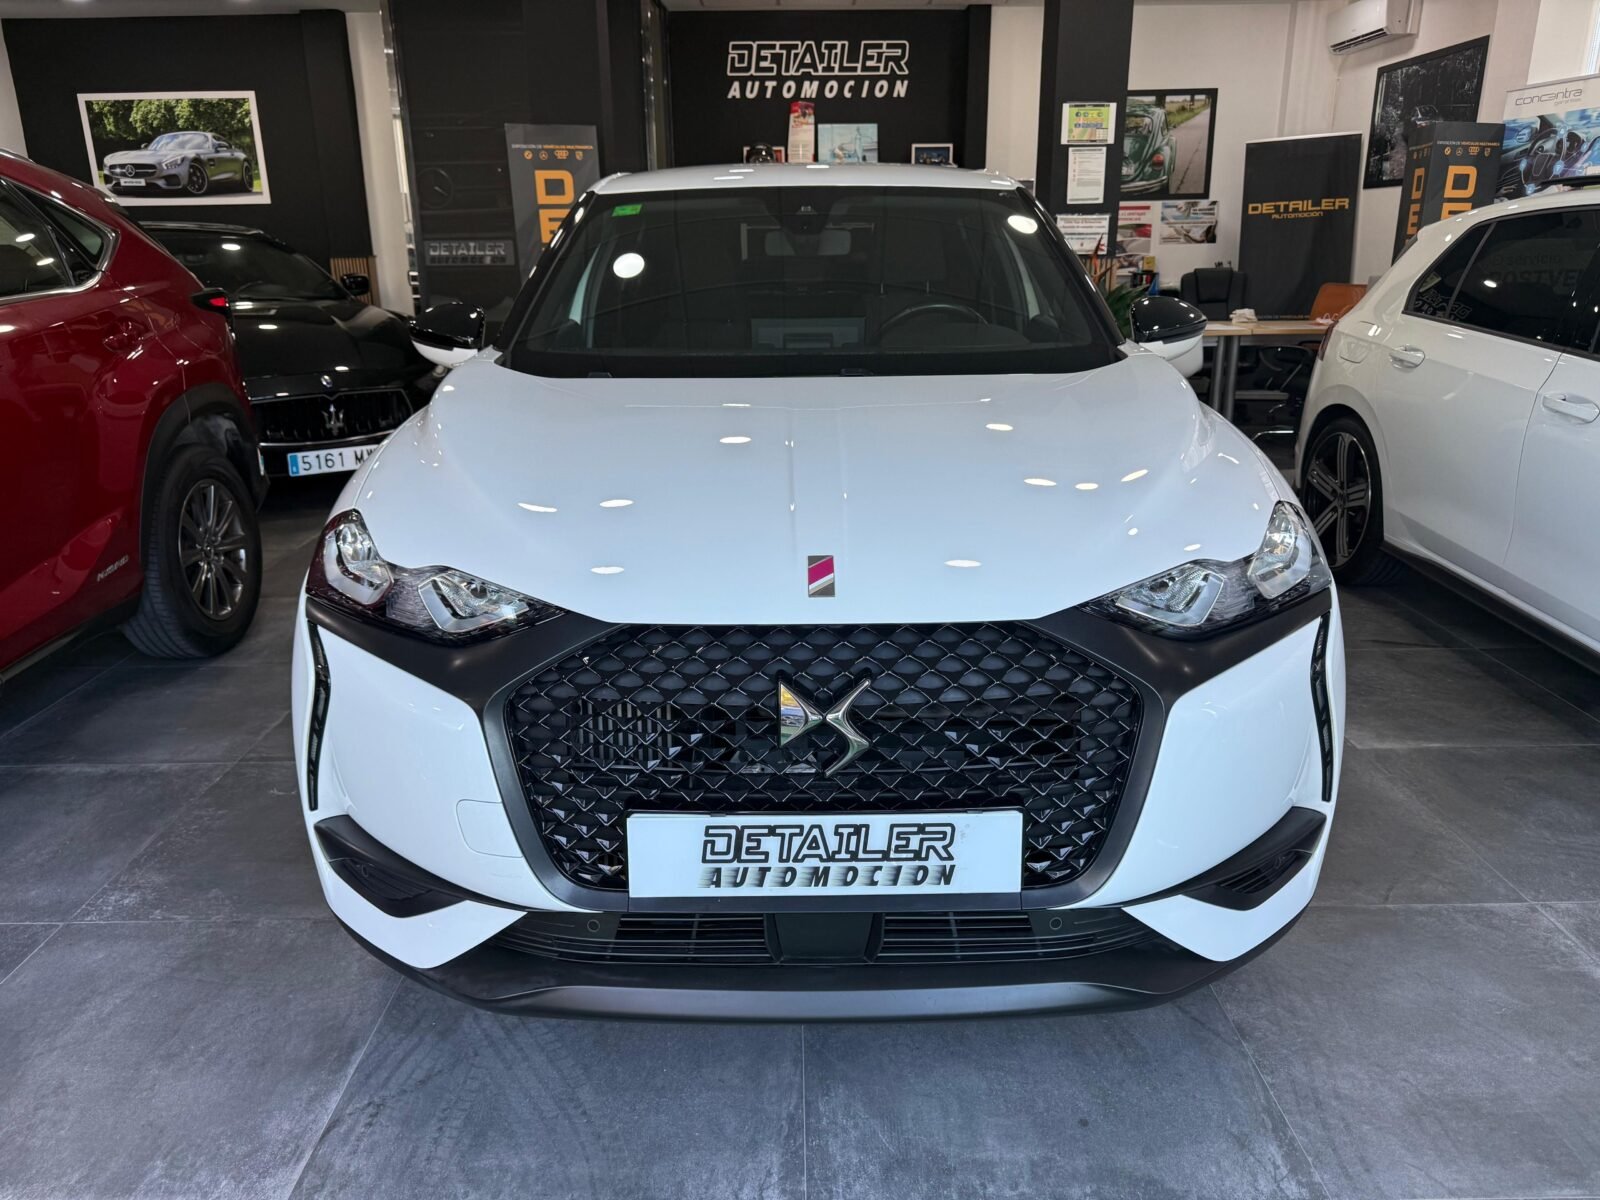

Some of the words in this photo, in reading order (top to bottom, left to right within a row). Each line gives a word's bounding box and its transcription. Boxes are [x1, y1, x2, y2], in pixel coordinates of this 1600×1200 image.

[727, 41, 909, 76] DETAILER
[727, 80, 909, 99] AUTOMOCION
[1515, 88, 1582, 106] concentra
[1247, 197, 1350, 215] DETAILER
[429, 242, 505, 256] DETAILER
[301, 452, 344, 471] 5161
[702, 823, 955, 864] DETAILER
[698, 864, 955, 888] AUTOMOCION
